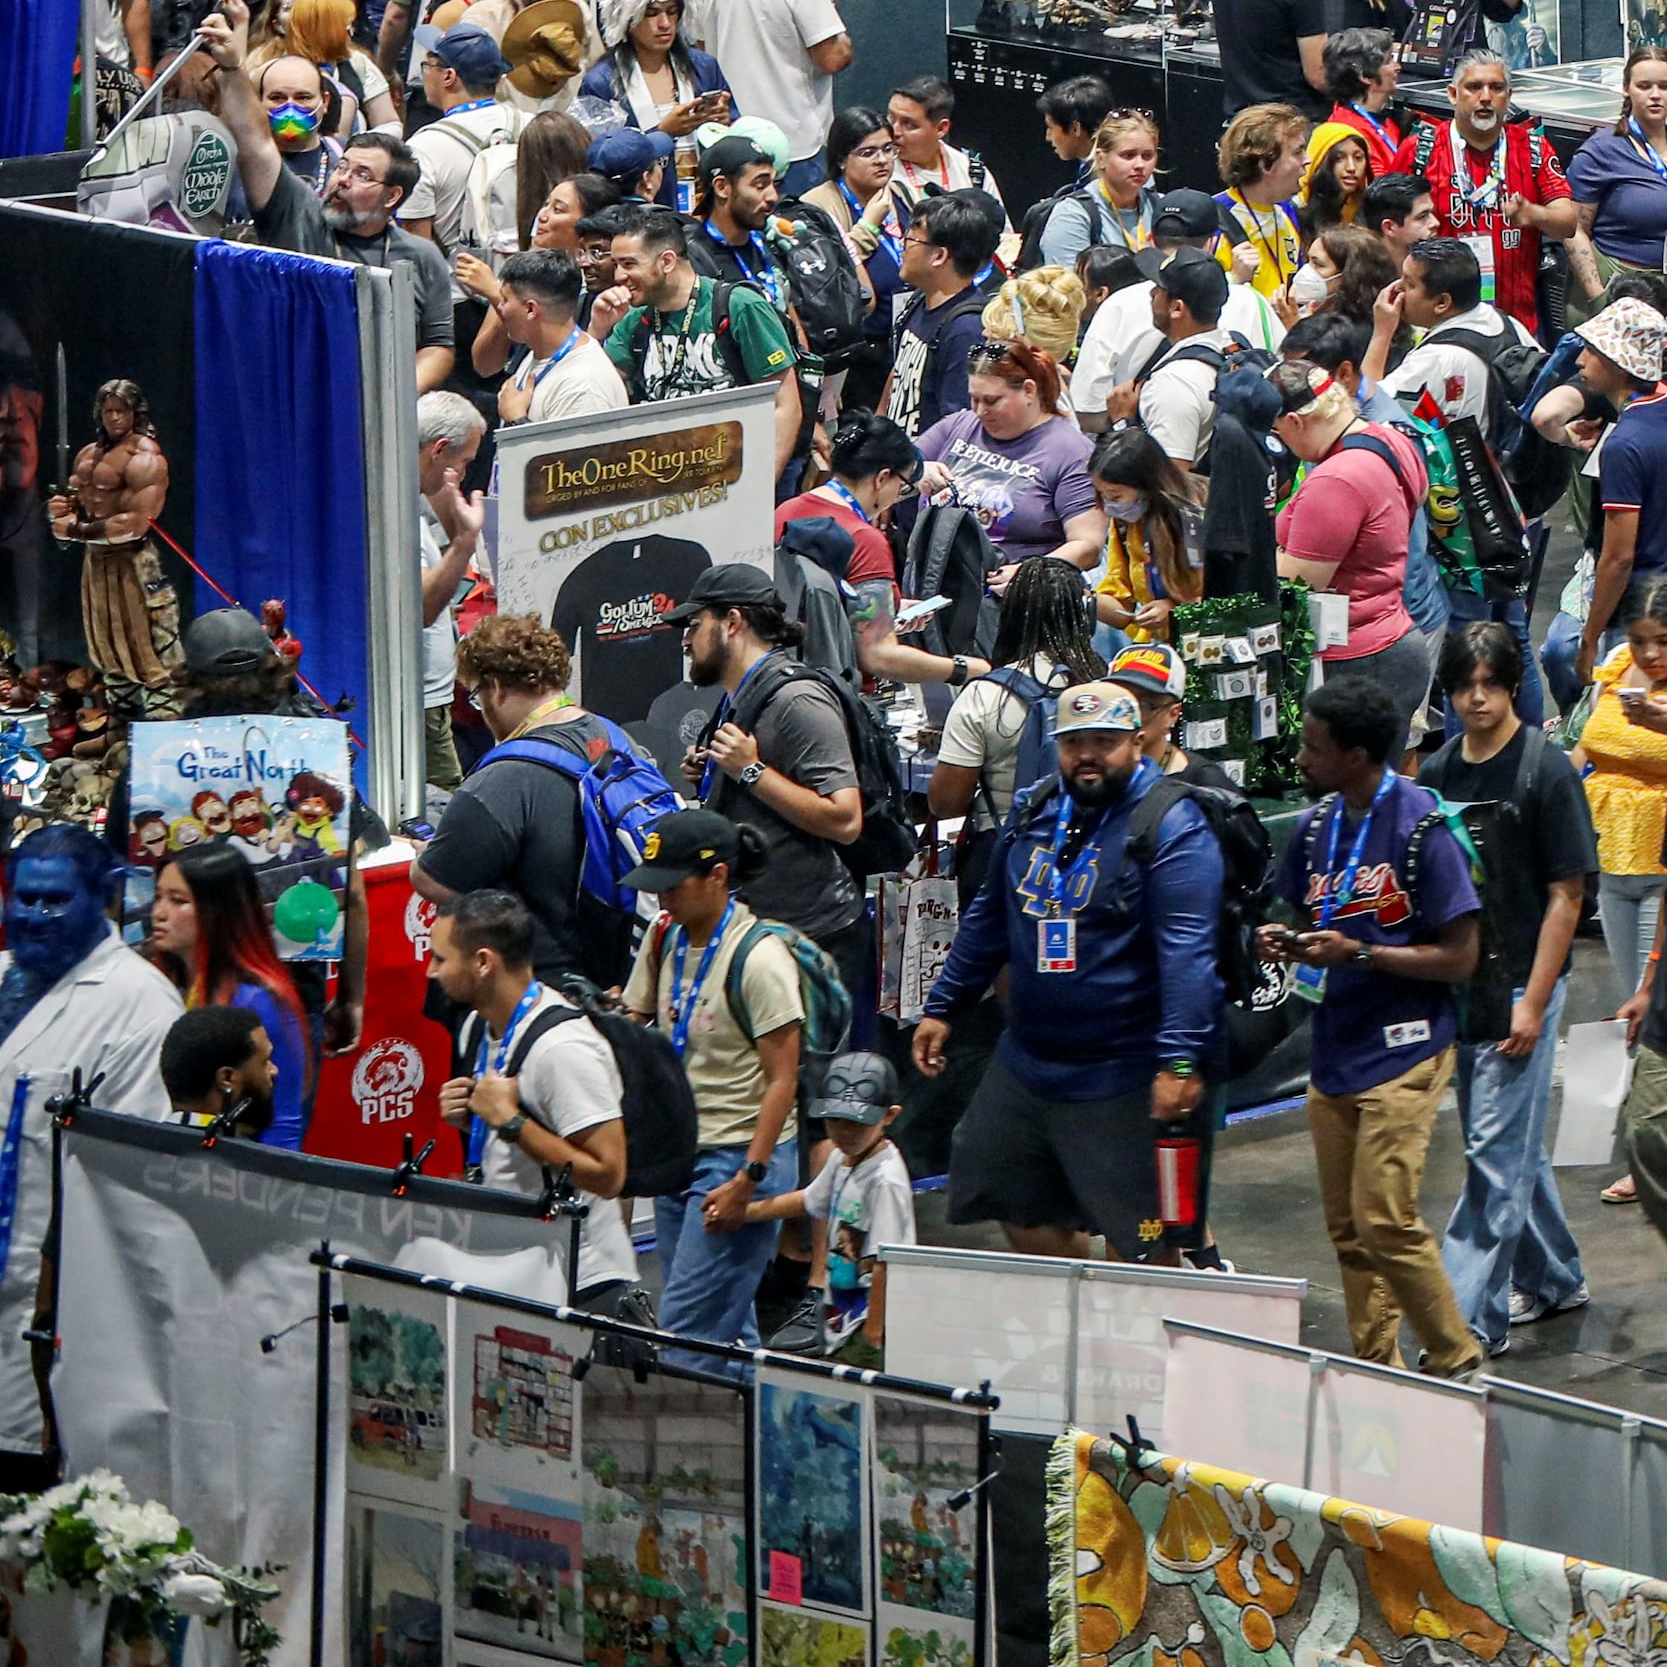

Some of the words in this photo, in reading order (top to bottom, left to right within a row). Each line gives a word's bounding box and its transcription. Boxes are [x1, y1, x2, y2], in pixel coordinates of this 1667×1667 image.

[540, 433, 728, 494] TheOneRing.net
[950, 439, 1041, 479] BEETLEJUICE
[540, 521, 588, 555] CON
[592, 480, 728, 539] EXCLUSIVES!
[178, 751, 241, 783] Great
[204, 746, 229, 760] The
[361, 1091, 414, 1124] PCS
